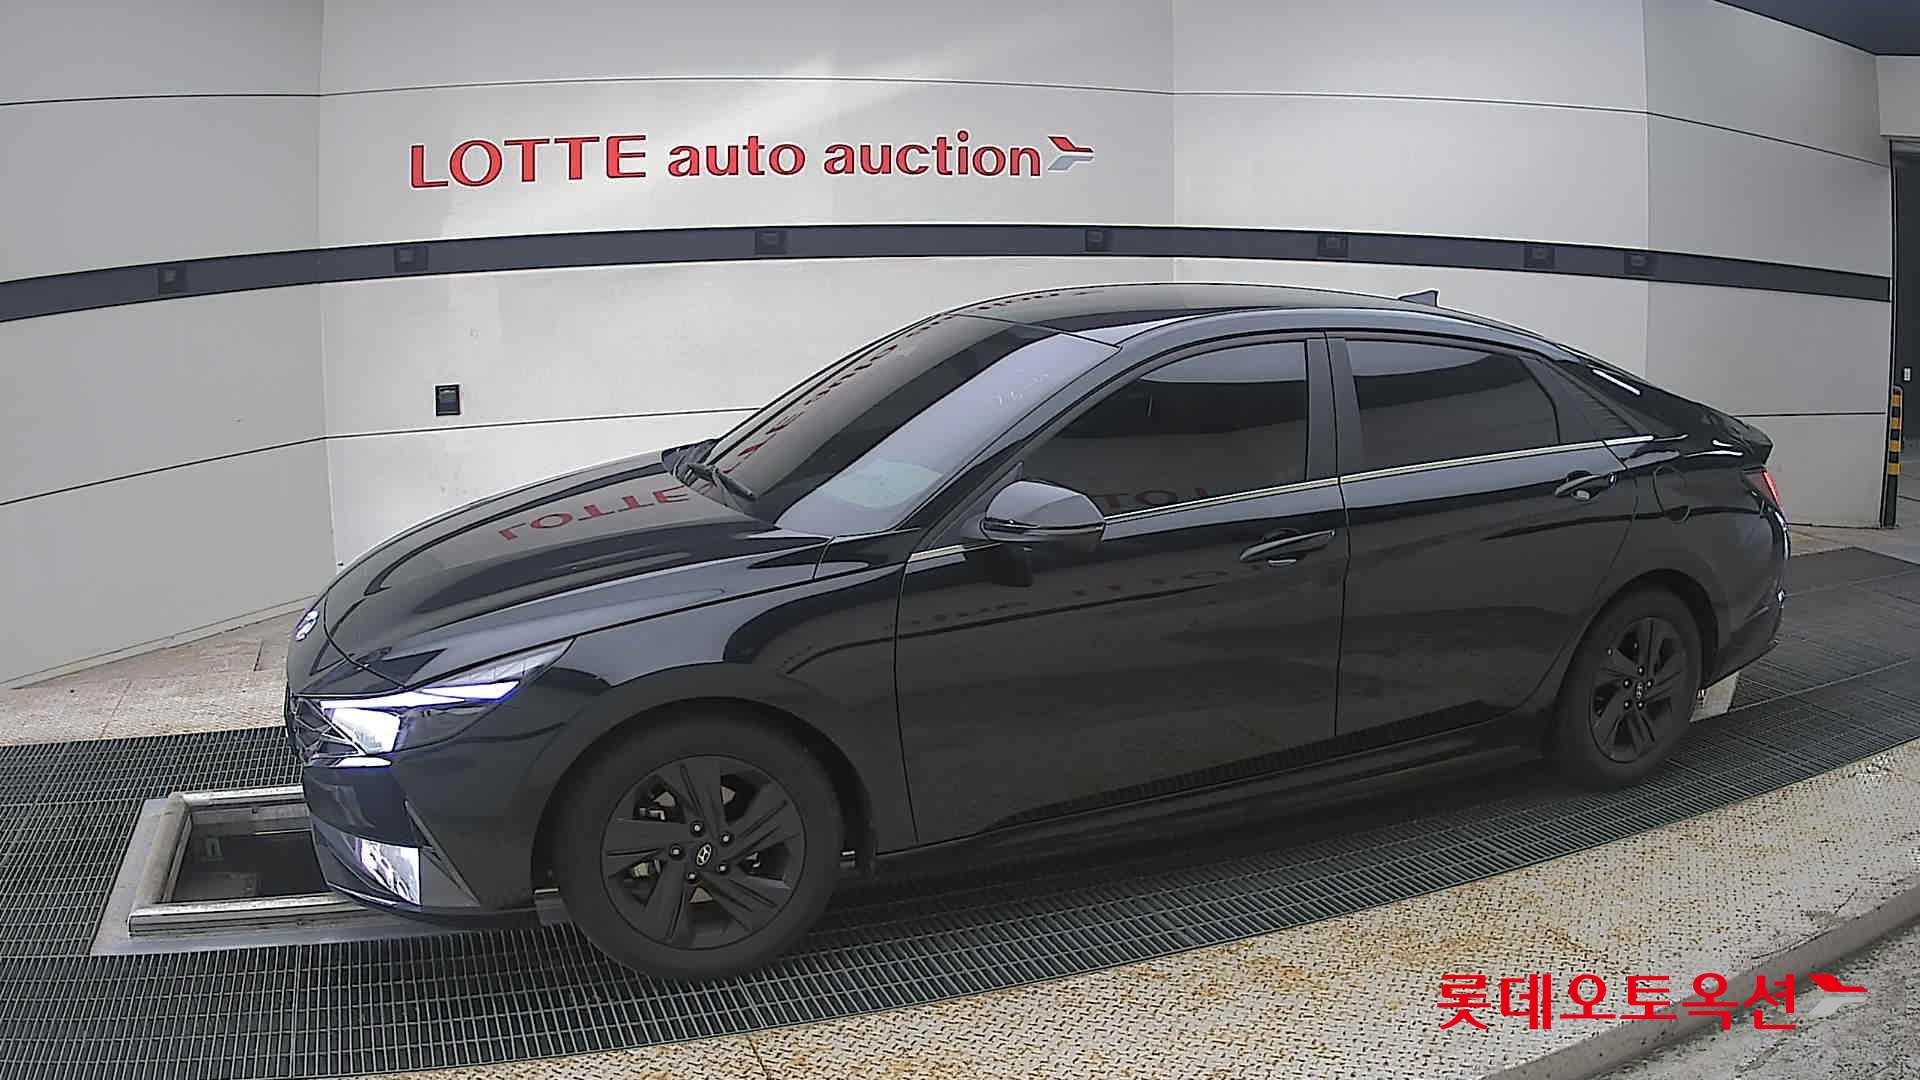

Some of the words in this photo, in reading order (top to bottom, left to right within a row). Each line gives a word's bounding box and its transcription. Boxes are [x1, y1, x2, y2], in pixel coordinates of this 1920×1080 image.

[410, 134, 646, 189] LOTTE
[667, 135, 806, 177] auto
[824, 130, 1042, 177] auction
